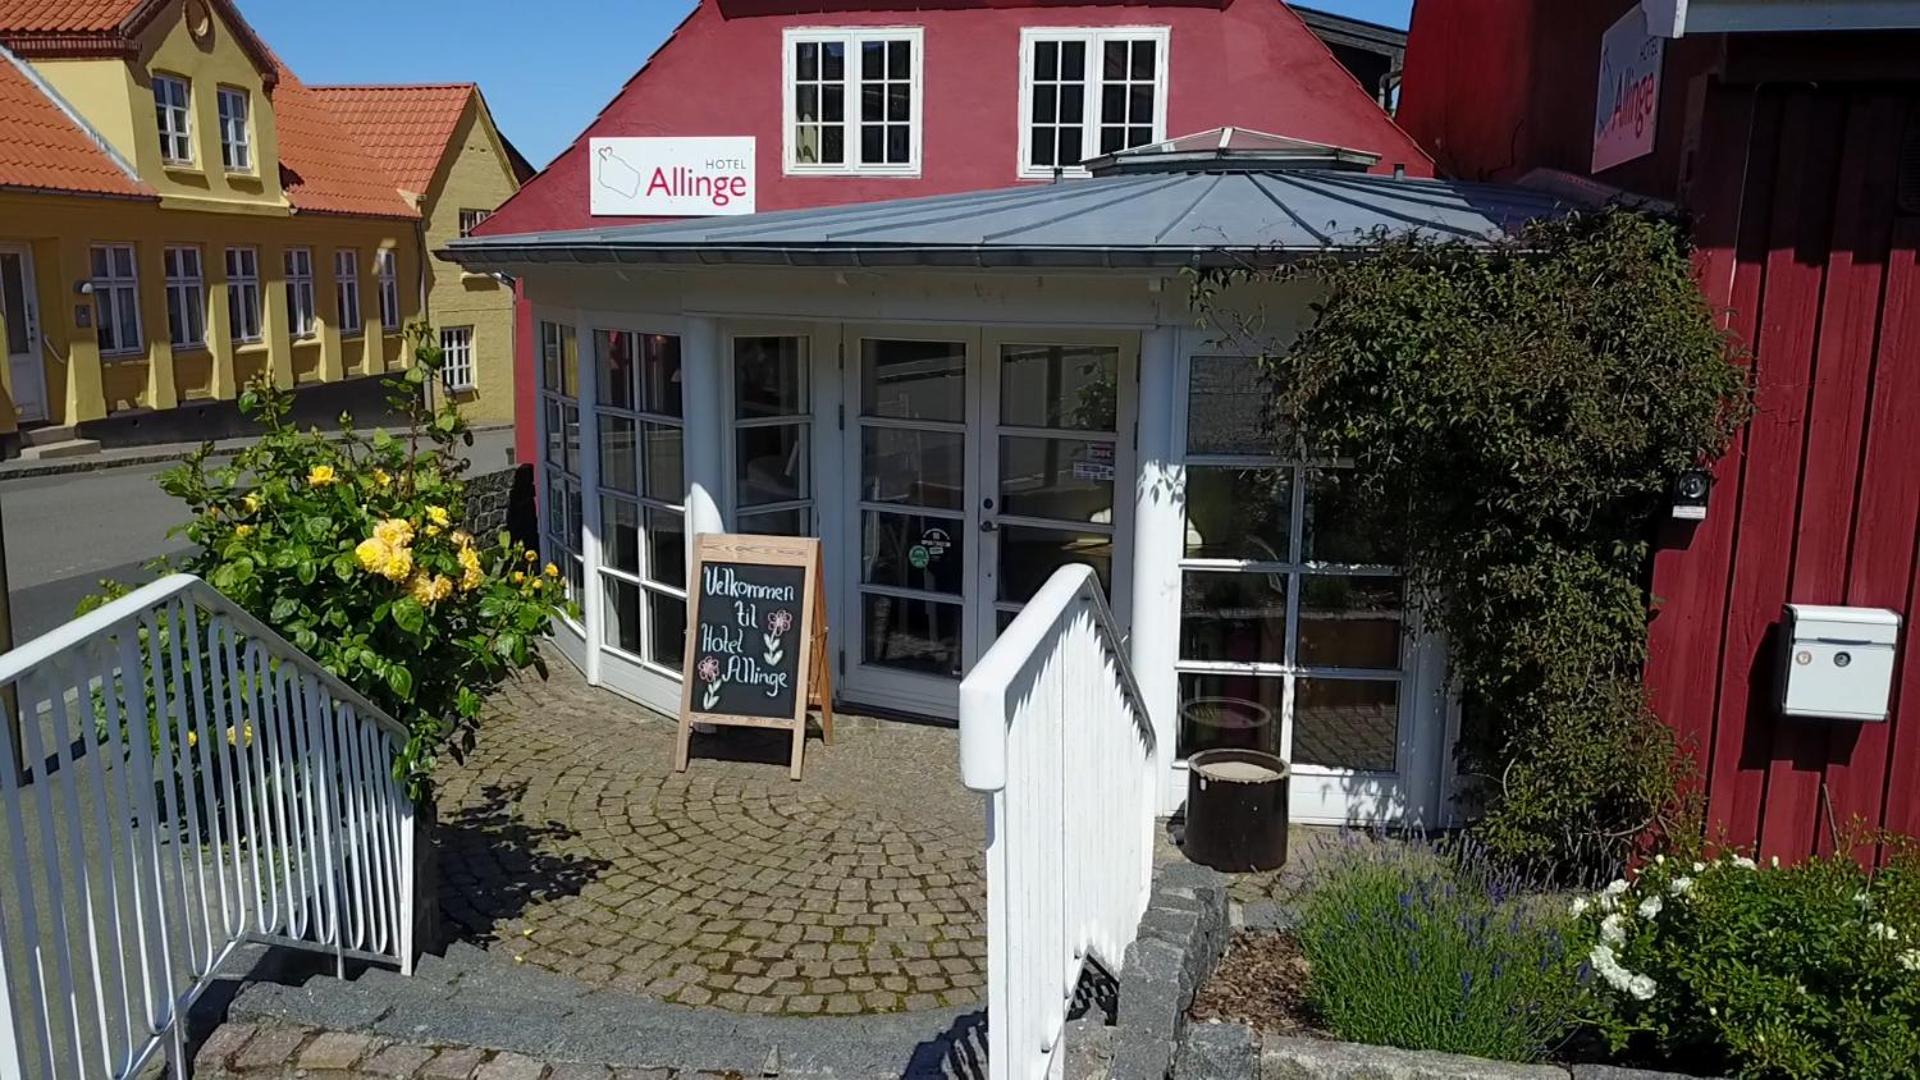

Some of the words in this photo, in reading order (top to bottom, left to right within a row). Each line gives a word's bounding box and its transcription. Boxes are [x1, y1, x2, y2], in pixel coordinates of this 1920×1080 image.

[1640, 36, 1658, 61] HOTEL
[1612, 66, 1655, 138] Allinge
[706, 159, 746, 170] HOTEL
[646, 166, 746, 206] Allinge
[703, 566, 794, 600] Velkommen
[734, 601, 758, 628] til
[701, 623, 743, 654] Hotel
[722, 655, 788, 697] Allinge
